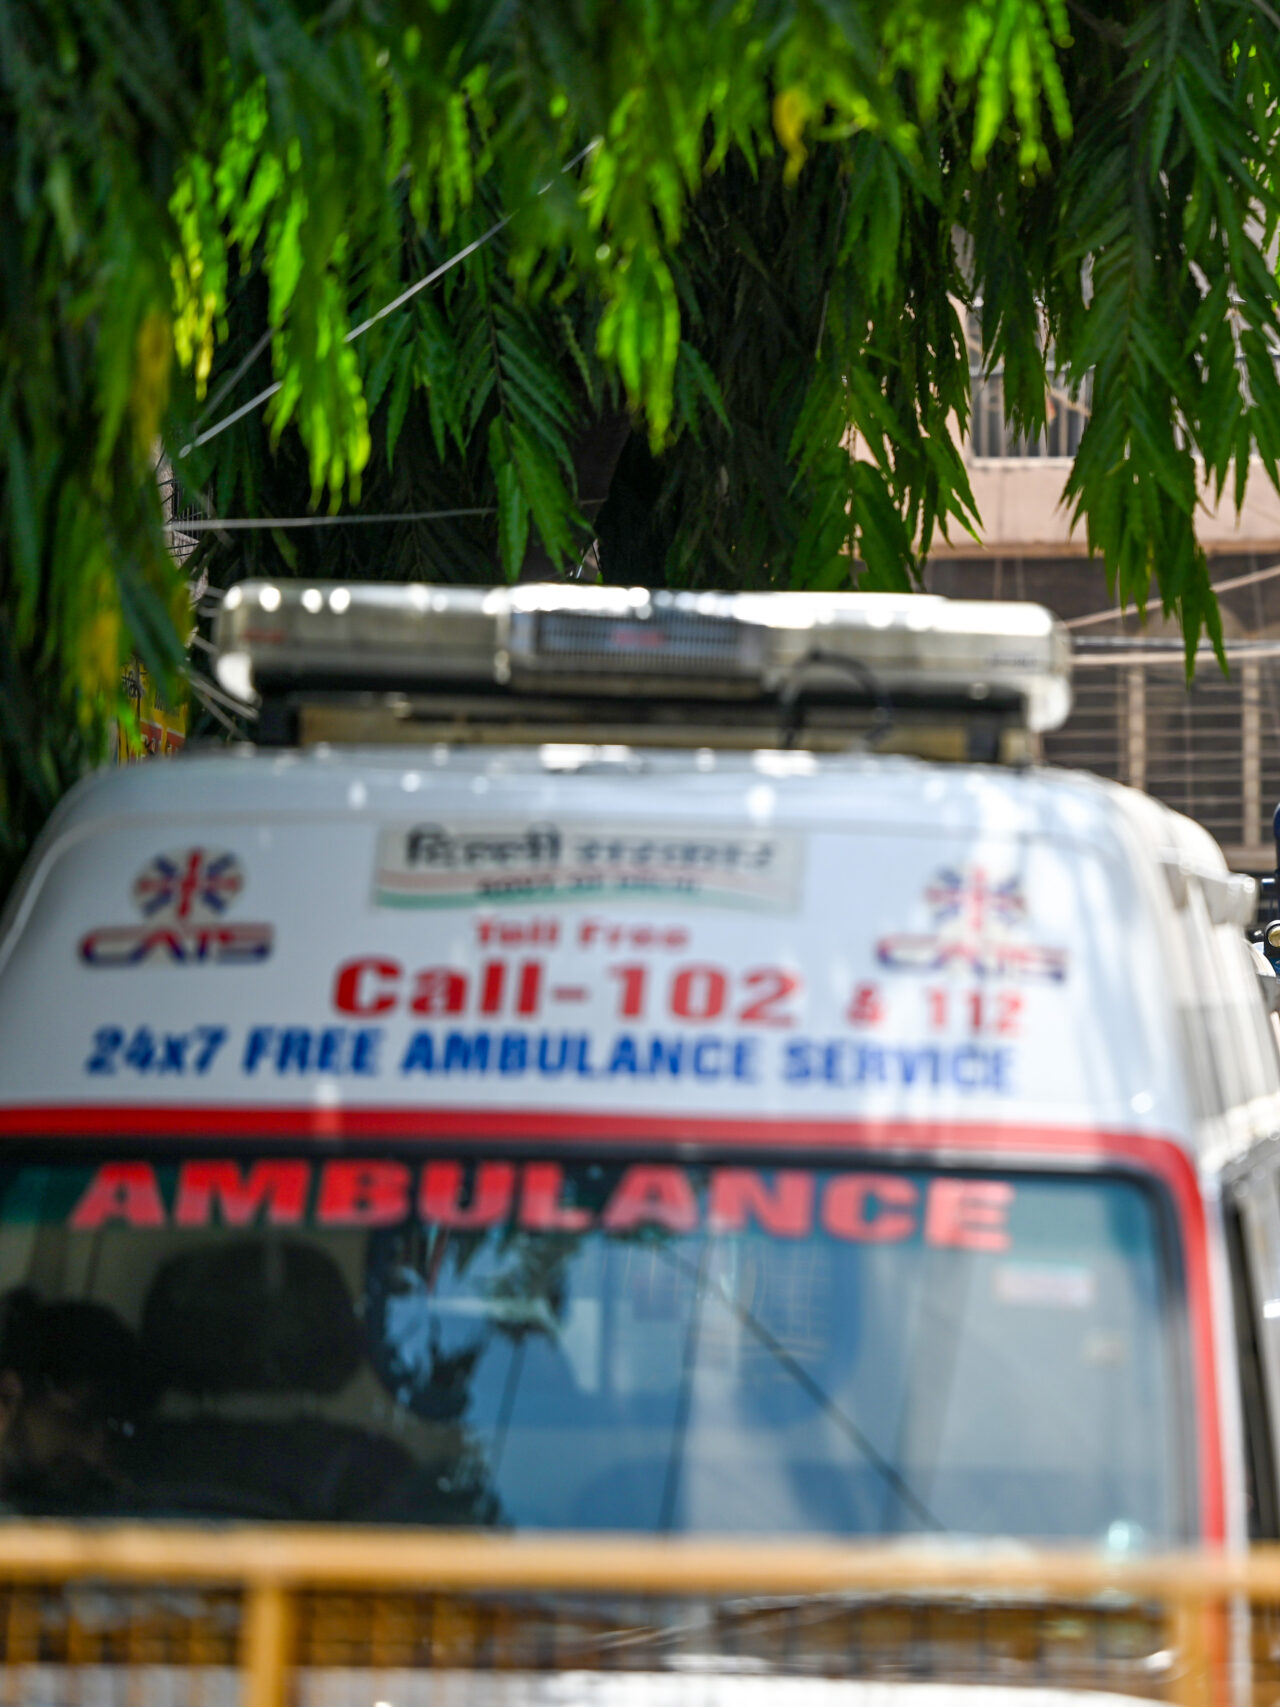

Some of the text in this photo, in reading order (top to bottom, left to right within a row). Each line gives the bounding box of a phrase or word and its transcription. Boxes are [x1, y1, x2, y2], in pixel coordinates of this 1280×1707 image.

[405, 821, 562, 869] दिल्ली
[474, 914, 690, 952] Toll Free
[331, 956, 803, 1030] Call-102
[924, 986, 1025, 1036] 112
[85, 1025, 1018, 1096] 24x7 FREE AMBULANCE SERVICE
[69, 1159, 1015, 1253] AMBULANCE
